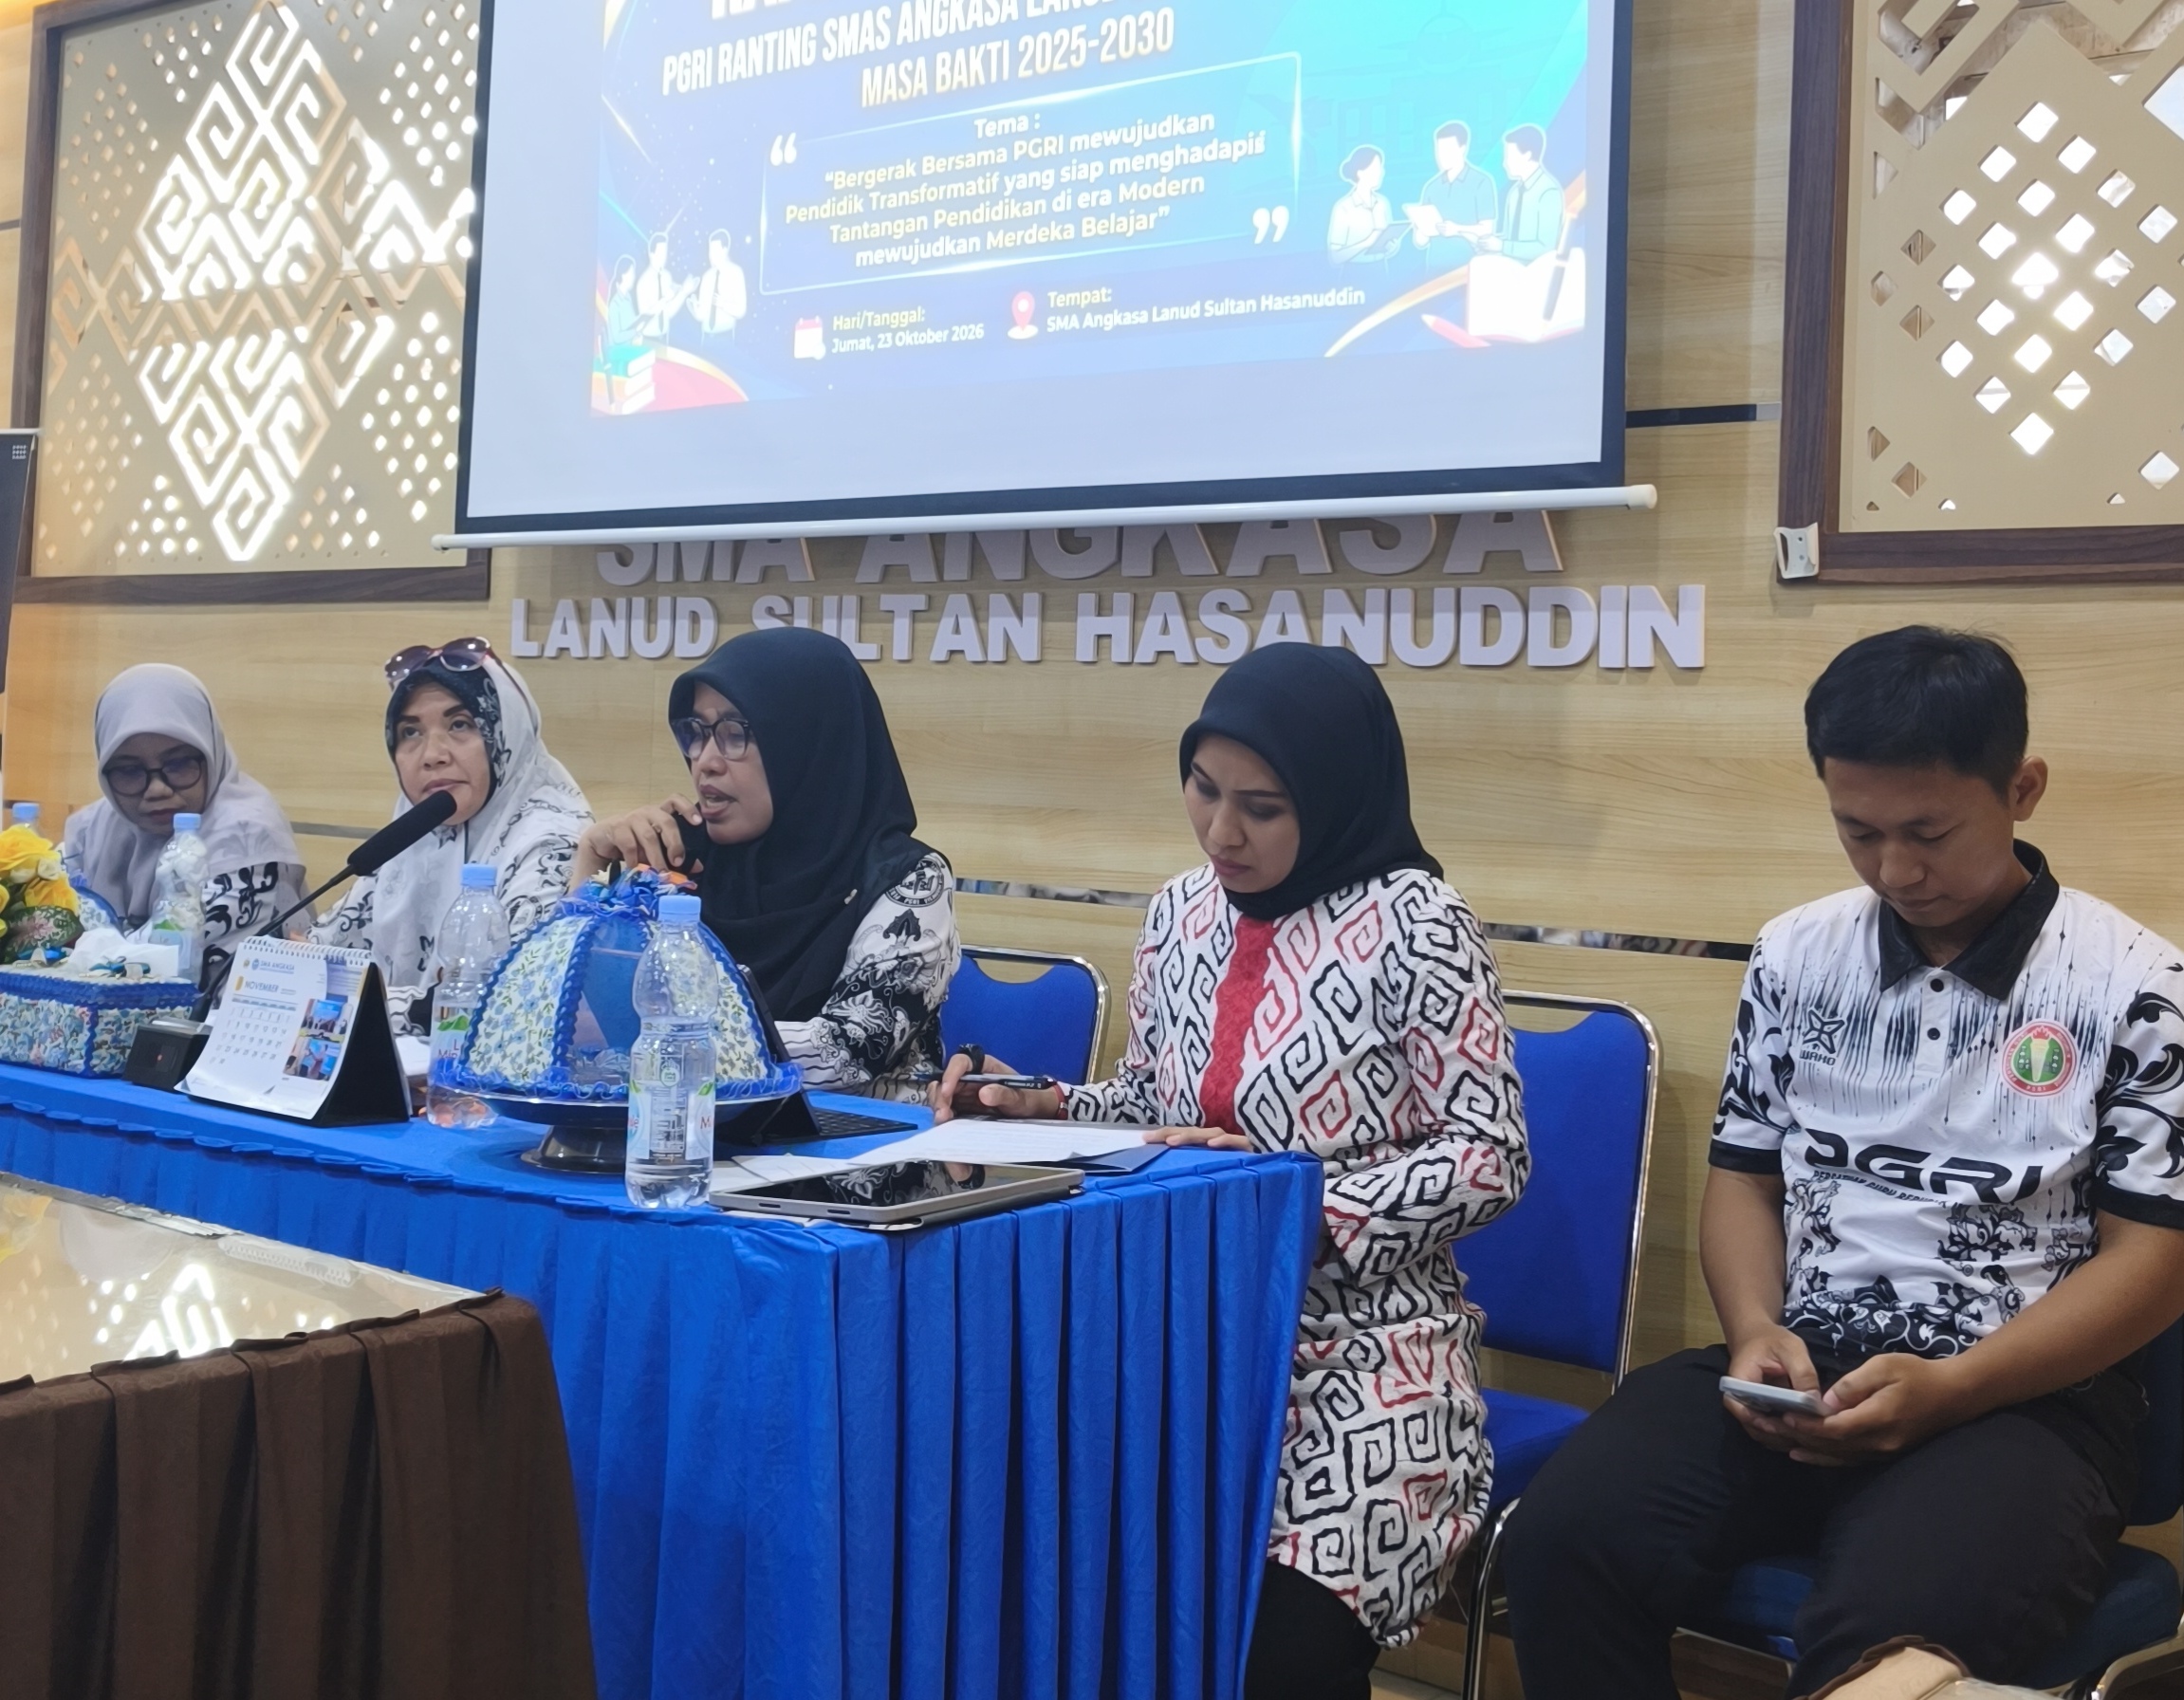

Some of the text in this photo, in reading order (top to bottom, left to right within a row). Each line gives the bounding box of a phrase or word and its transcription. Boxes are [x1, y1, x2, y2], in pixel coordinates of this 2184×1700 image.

[662, 0, 1019, 96] PGRI RANTING SMAS ANGKASA
[861, 7, 1175, 107] MASA BAKTI 2025-2030
[922, 147, 1008, 176] Bersama
[1013, 135, 1064, 160] PGRI
[1069, 113, 1215, 152] mewujudkan
[973, 115, 1029, 139] Tema
[786, 194, 864, 224] Pendidik
[869, 172, 999, 211] Transformatif
[1004, 168, 1055, 196] yang
[1060, 158, 1104, 183] siap
[830, 176, 1205, 243] Tantangan Pendidikan di era Modern
[855, 234, 981, 267] mewujudkan
[986, 220, 1075, 250] Merdeka
[832, 305, 926, 331] Hari/Tanggal:
[1046, 286, 1366, 332] SMA Angkasa Lanud Sultan Hasanuddin
[1047, 286, 1113, 309] Tempat:
[831, 323, 985, 354] Jumat, 23 Oktober 2026
[510, 595, 719, 659] LANUD
[1075, 584, 1706, 669] HASANUDDIN
[1805, 1128, 2044, 1205] PGRI
